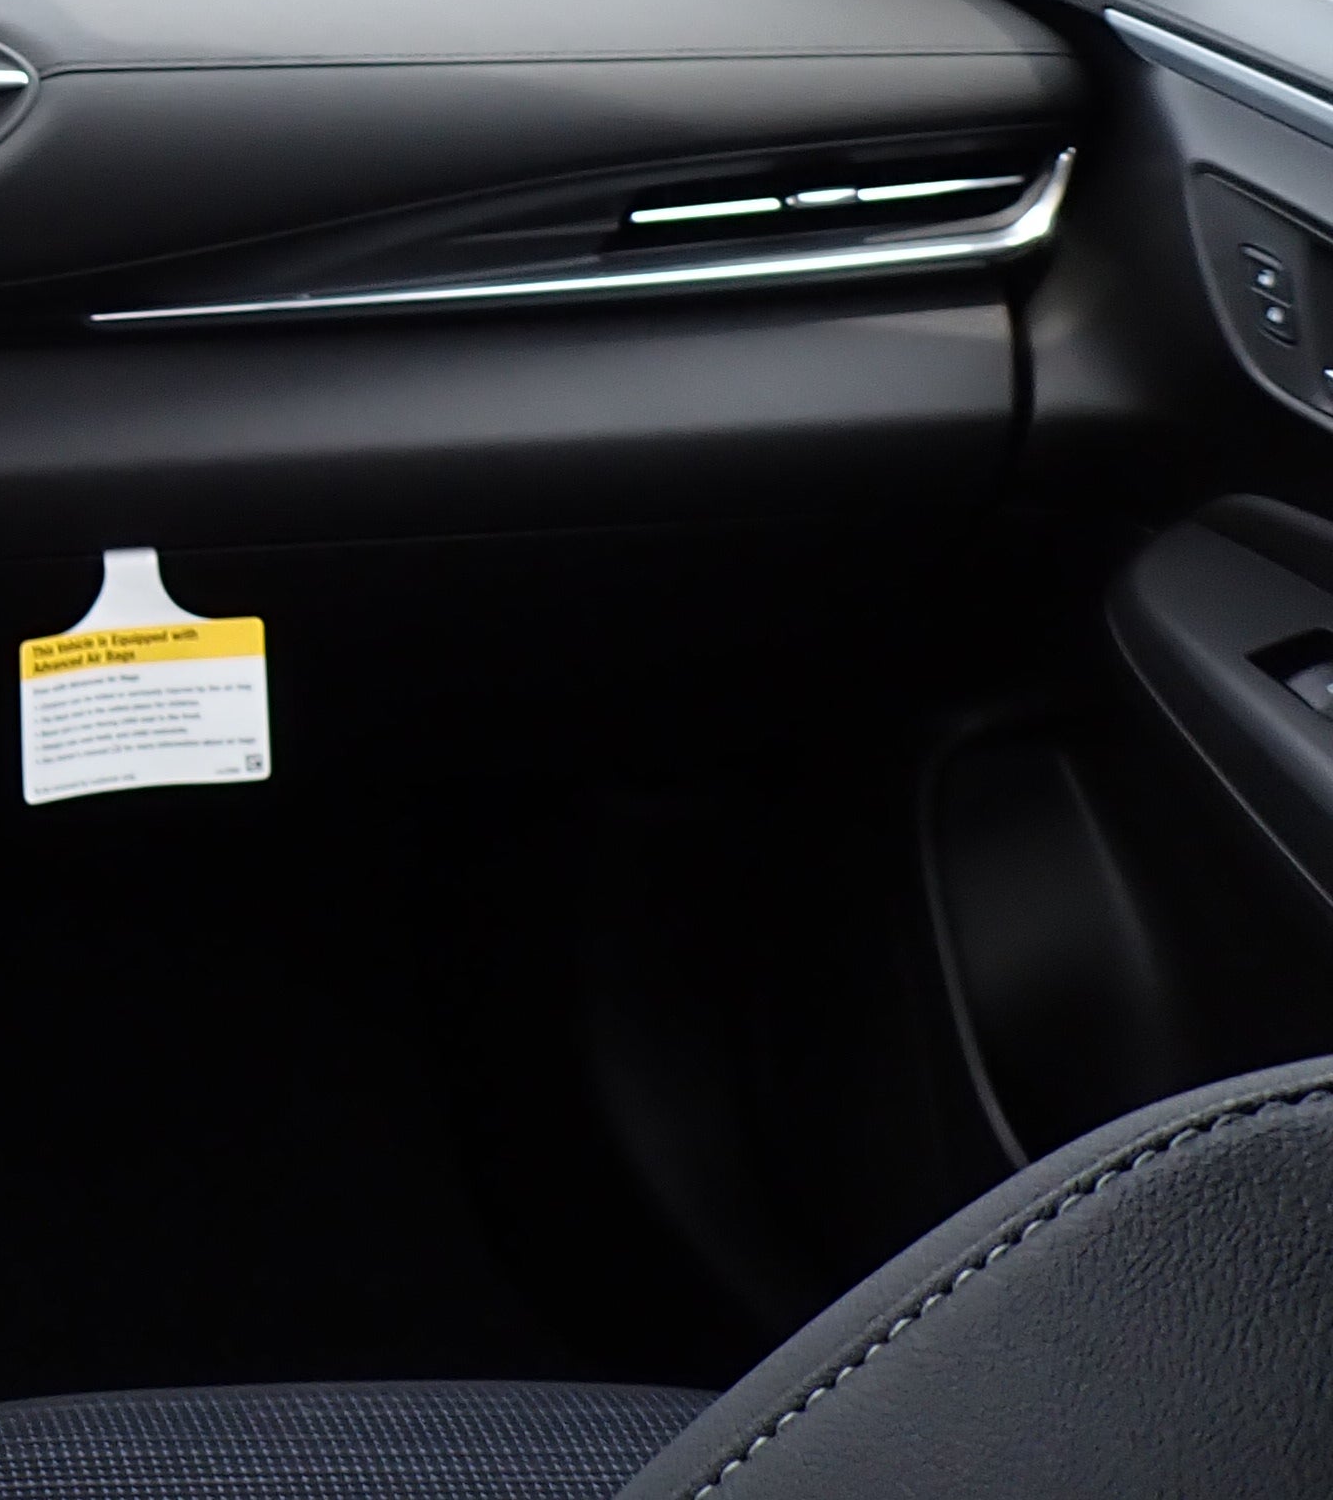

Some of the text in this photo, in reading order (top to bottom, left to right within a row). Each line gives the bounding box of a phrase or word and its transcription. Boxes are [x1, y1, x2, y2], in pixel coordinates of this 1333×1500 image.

[33, 644, 55, 656] This
[97, 635, 108, 647] is
[111, 630, 167, 647] Equipped
[172, 628, 199, 641] with
[33, 651, 135, 673] Advanced Air Bags
